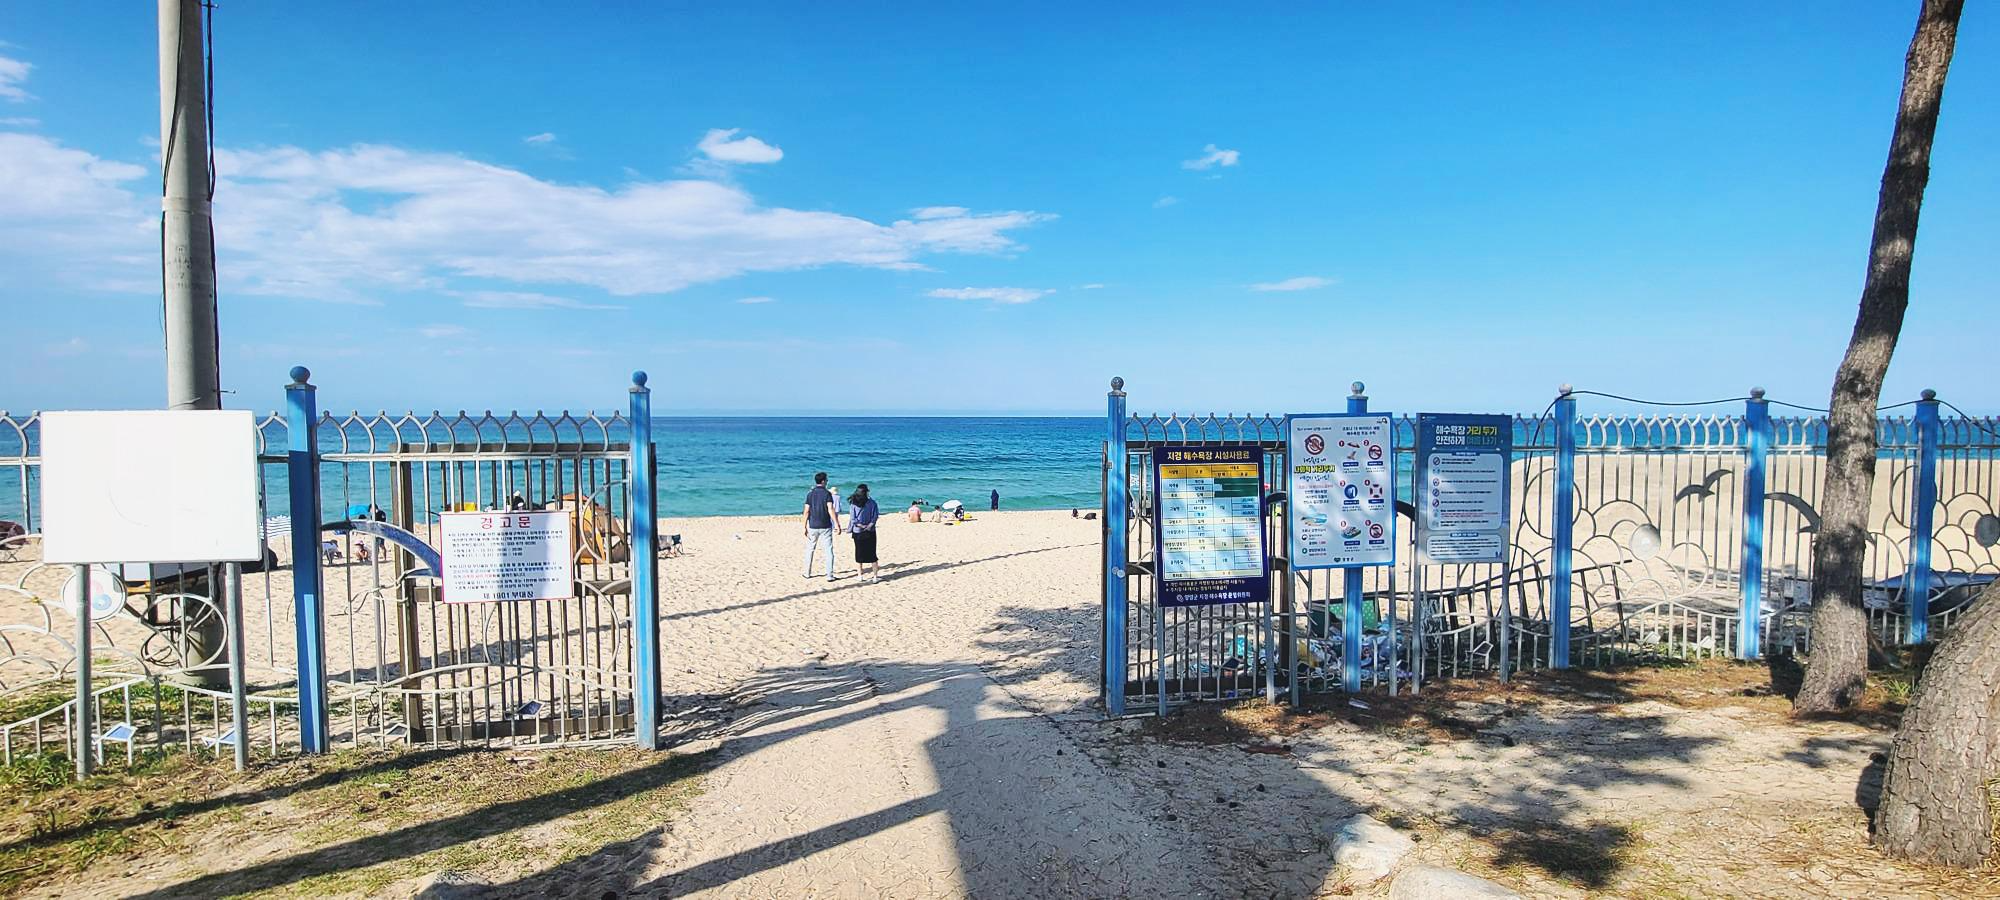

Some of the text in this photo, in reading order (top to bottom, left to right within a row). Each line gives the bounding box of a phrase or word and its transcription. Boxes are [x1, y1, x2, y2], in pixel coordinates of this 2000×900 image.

[1435, 425, 1497, 436] 해수욕장 거리 두기
[1435, 435, 1497, 445] 안전하게 여름 나기
[1167, 450, 1250, 461] 지경 해수욕장 시설사용료
